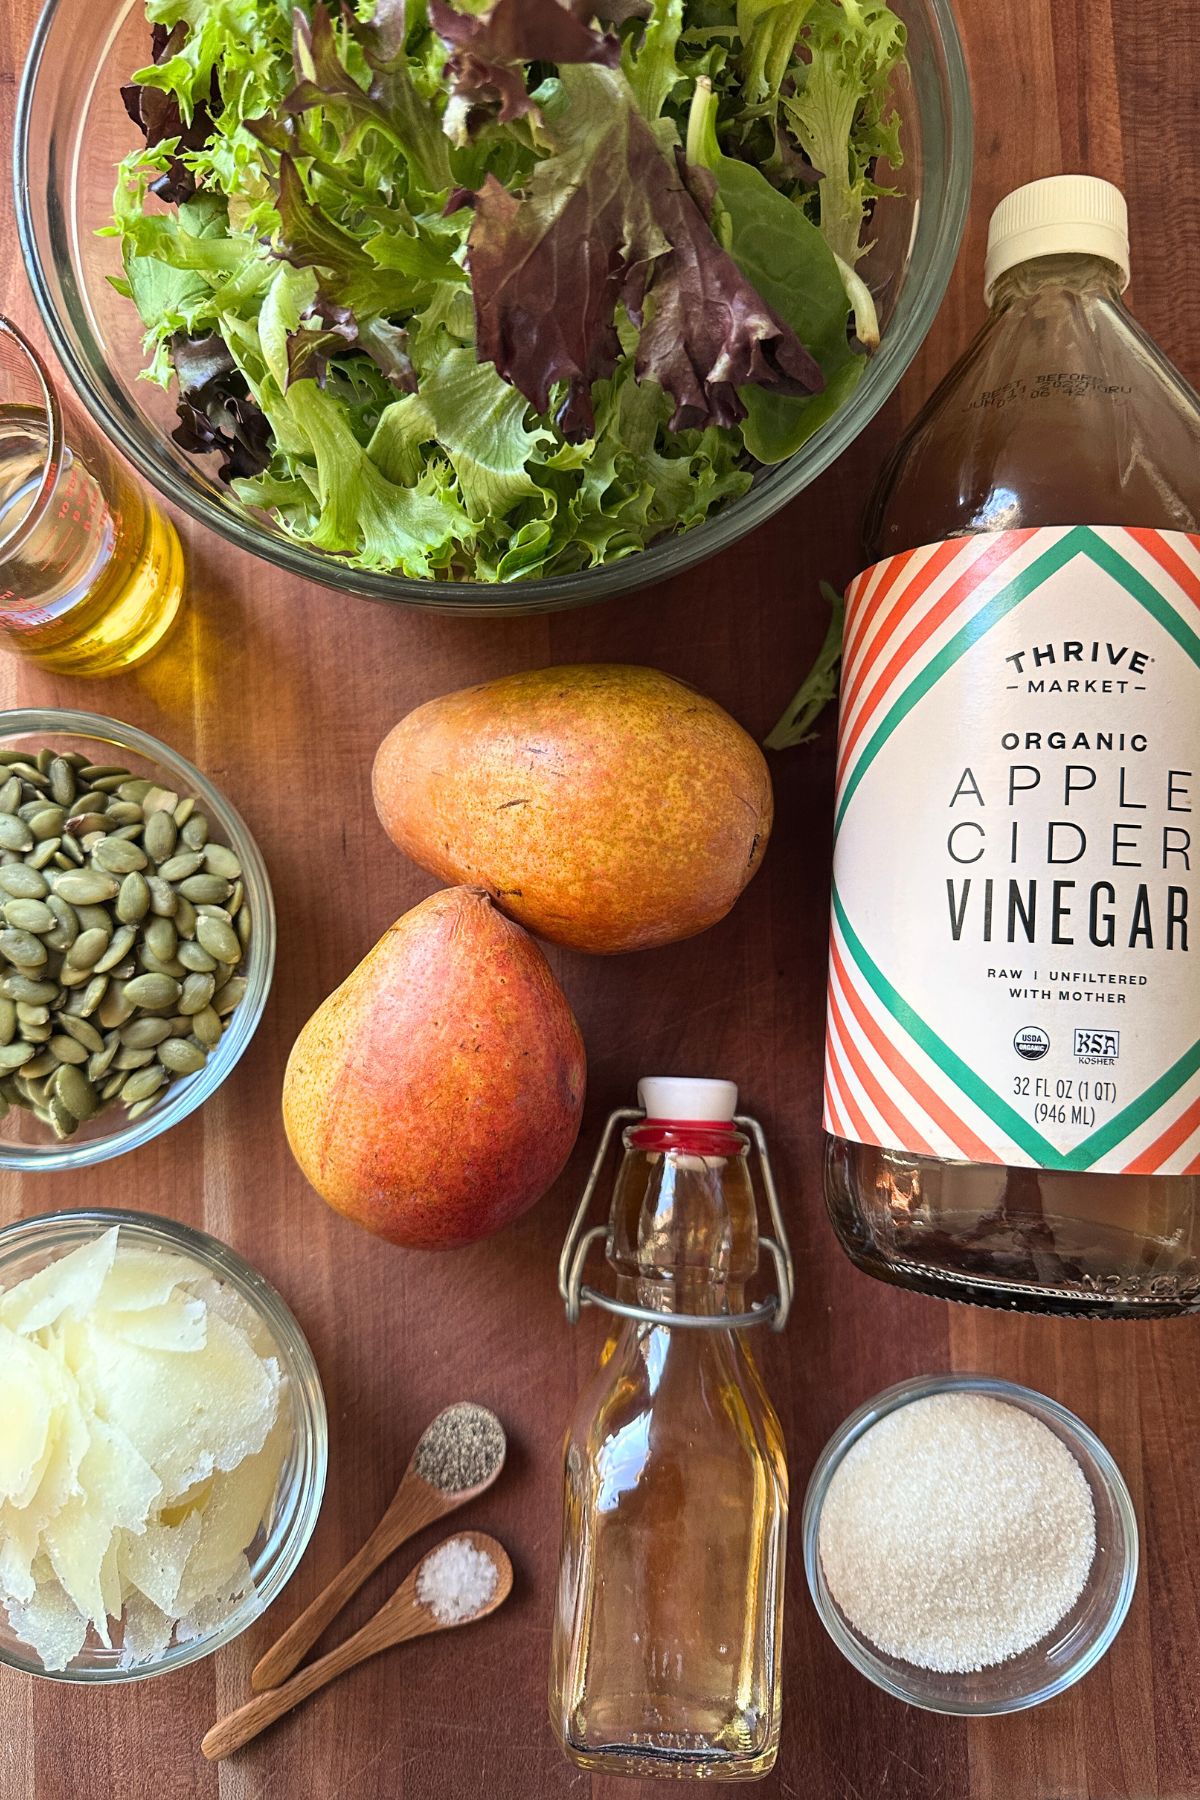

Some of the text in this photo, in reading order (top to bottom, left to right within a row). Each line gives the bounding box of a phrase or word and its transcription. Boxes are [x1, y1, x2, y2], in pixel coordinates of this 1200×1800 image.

[1005, 641, 1150, 674] THRIVE
[1027, 679, 1129, 694] MARKET
[1001, 731, 1148, 752] ORGANIC
[948, 765, 1193, 813] APPLE
[946, 821, 1192, 871] CIDER
[946, 878, 1189, 951] VINEGAR
[987, 968, 1023, 980] RAW
[1049, 971, 1148, 986] UNFILTERED
[1009, 988, 1126, 1004] WITH MOTHER
[1021, 1034, 1043, 1043] USDA
[1077, 1032, 1117, 1055] KSA
[1078, 1056, 1116, 1066] KOSHER
[1013, 1076, 1117, 1103] 32 FL OZ (1 QT)
[1034, 1102, 1096, 1128] (946 ML)
